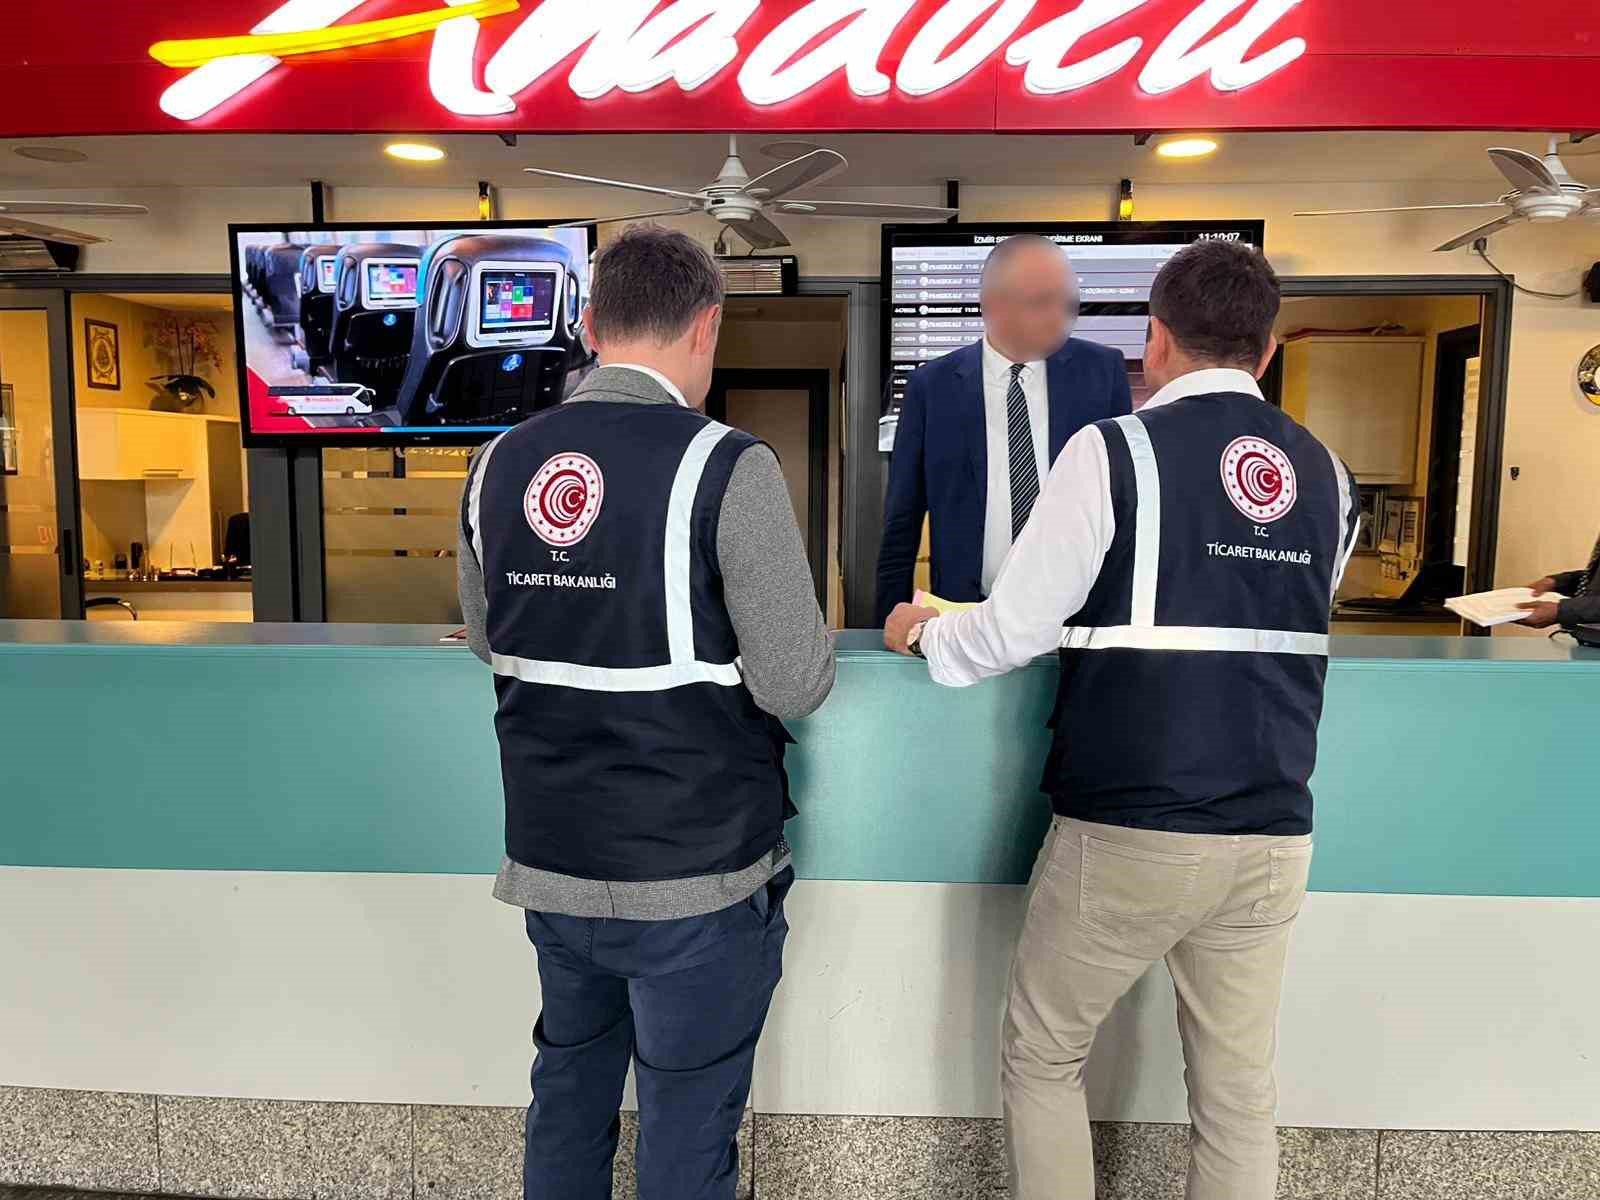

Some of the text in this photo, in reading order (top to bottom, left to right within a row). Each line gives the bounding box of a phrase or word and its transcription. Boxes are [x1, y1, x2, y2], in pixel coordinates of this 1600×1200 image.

[1253, 525, 1269, 537] T.C.
[550, 550, 570, 562] T.C.
[1206, 541, 1312, 565] TİCARET BAKANLIĞI
[506, 570, 616, 589] TİCARET BAKANLIĞI
